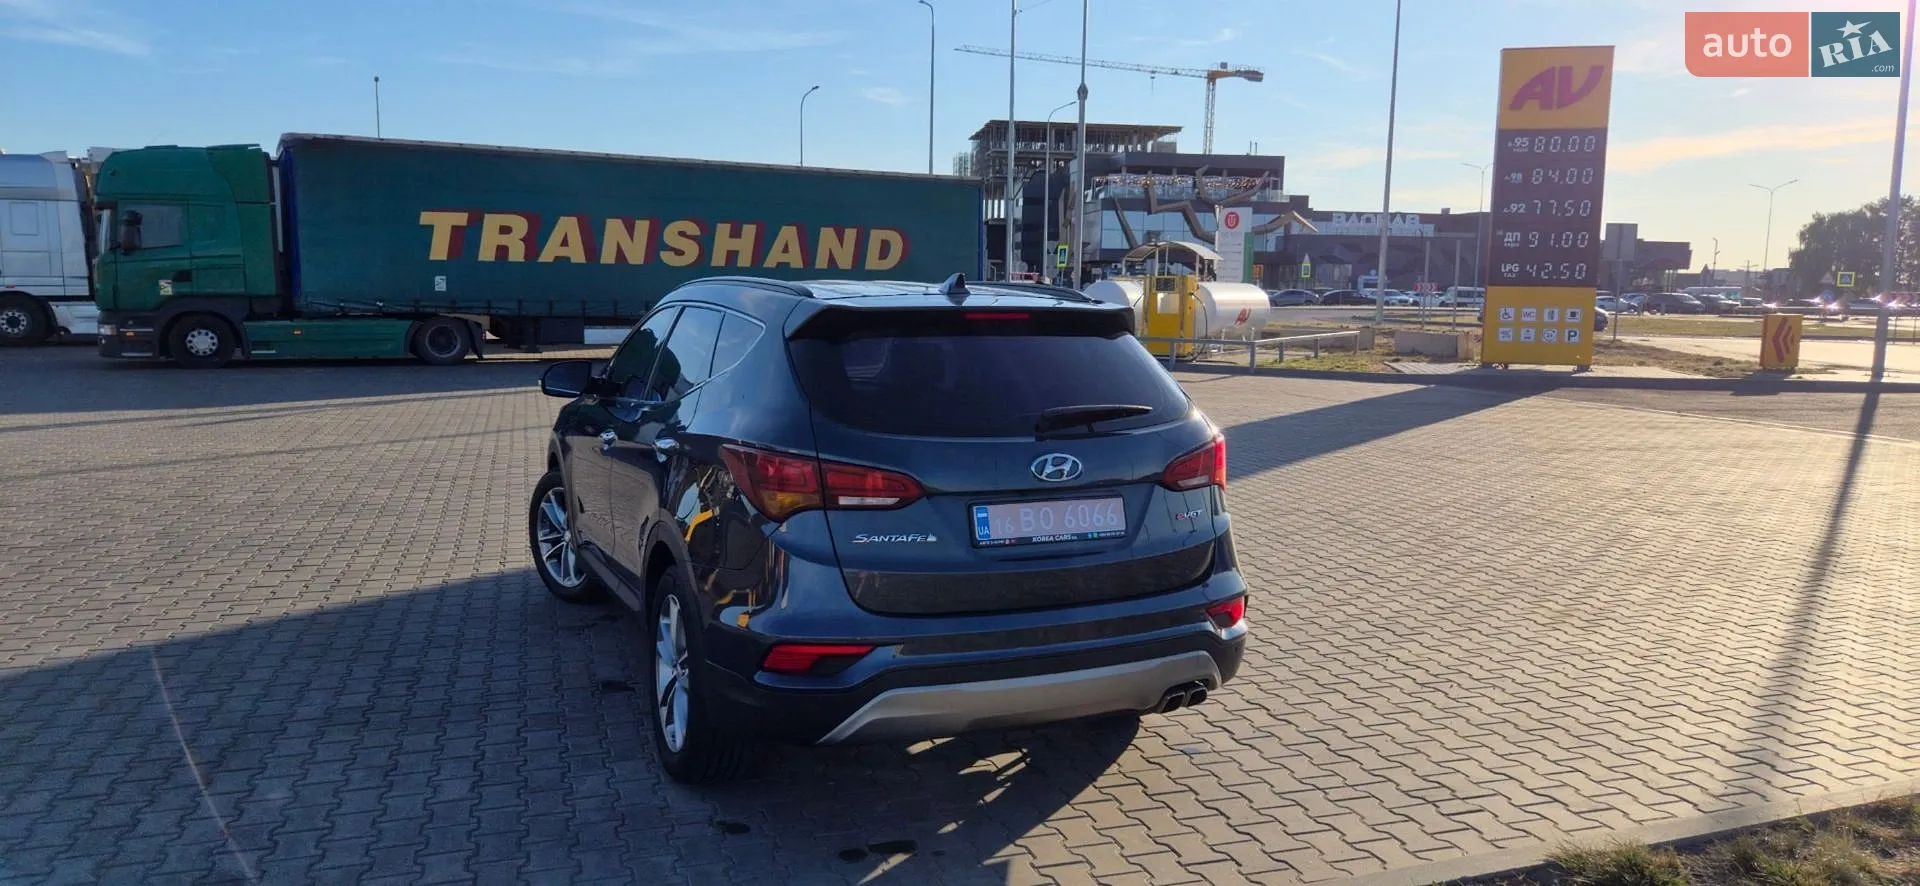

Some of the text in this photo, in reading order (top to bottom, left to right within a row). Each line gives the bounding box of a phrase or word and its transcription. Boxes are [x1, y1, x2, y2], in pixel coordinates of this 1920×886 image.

[1531, 168, 1594, 184] 84.00
[1532, 199, 1591, 216] 77.50
[419, 208, 909, 271] TRANSHAND
[1528, 231, 1589, 248] 91.00
[1501, 263, 1587, 279] LPG 42.50
[978, 502, 1118, 536] UA 16 BO 6066
[1032, 535, 1054, 543] KOREA
[1055, 534, 1072, 542] CARS
